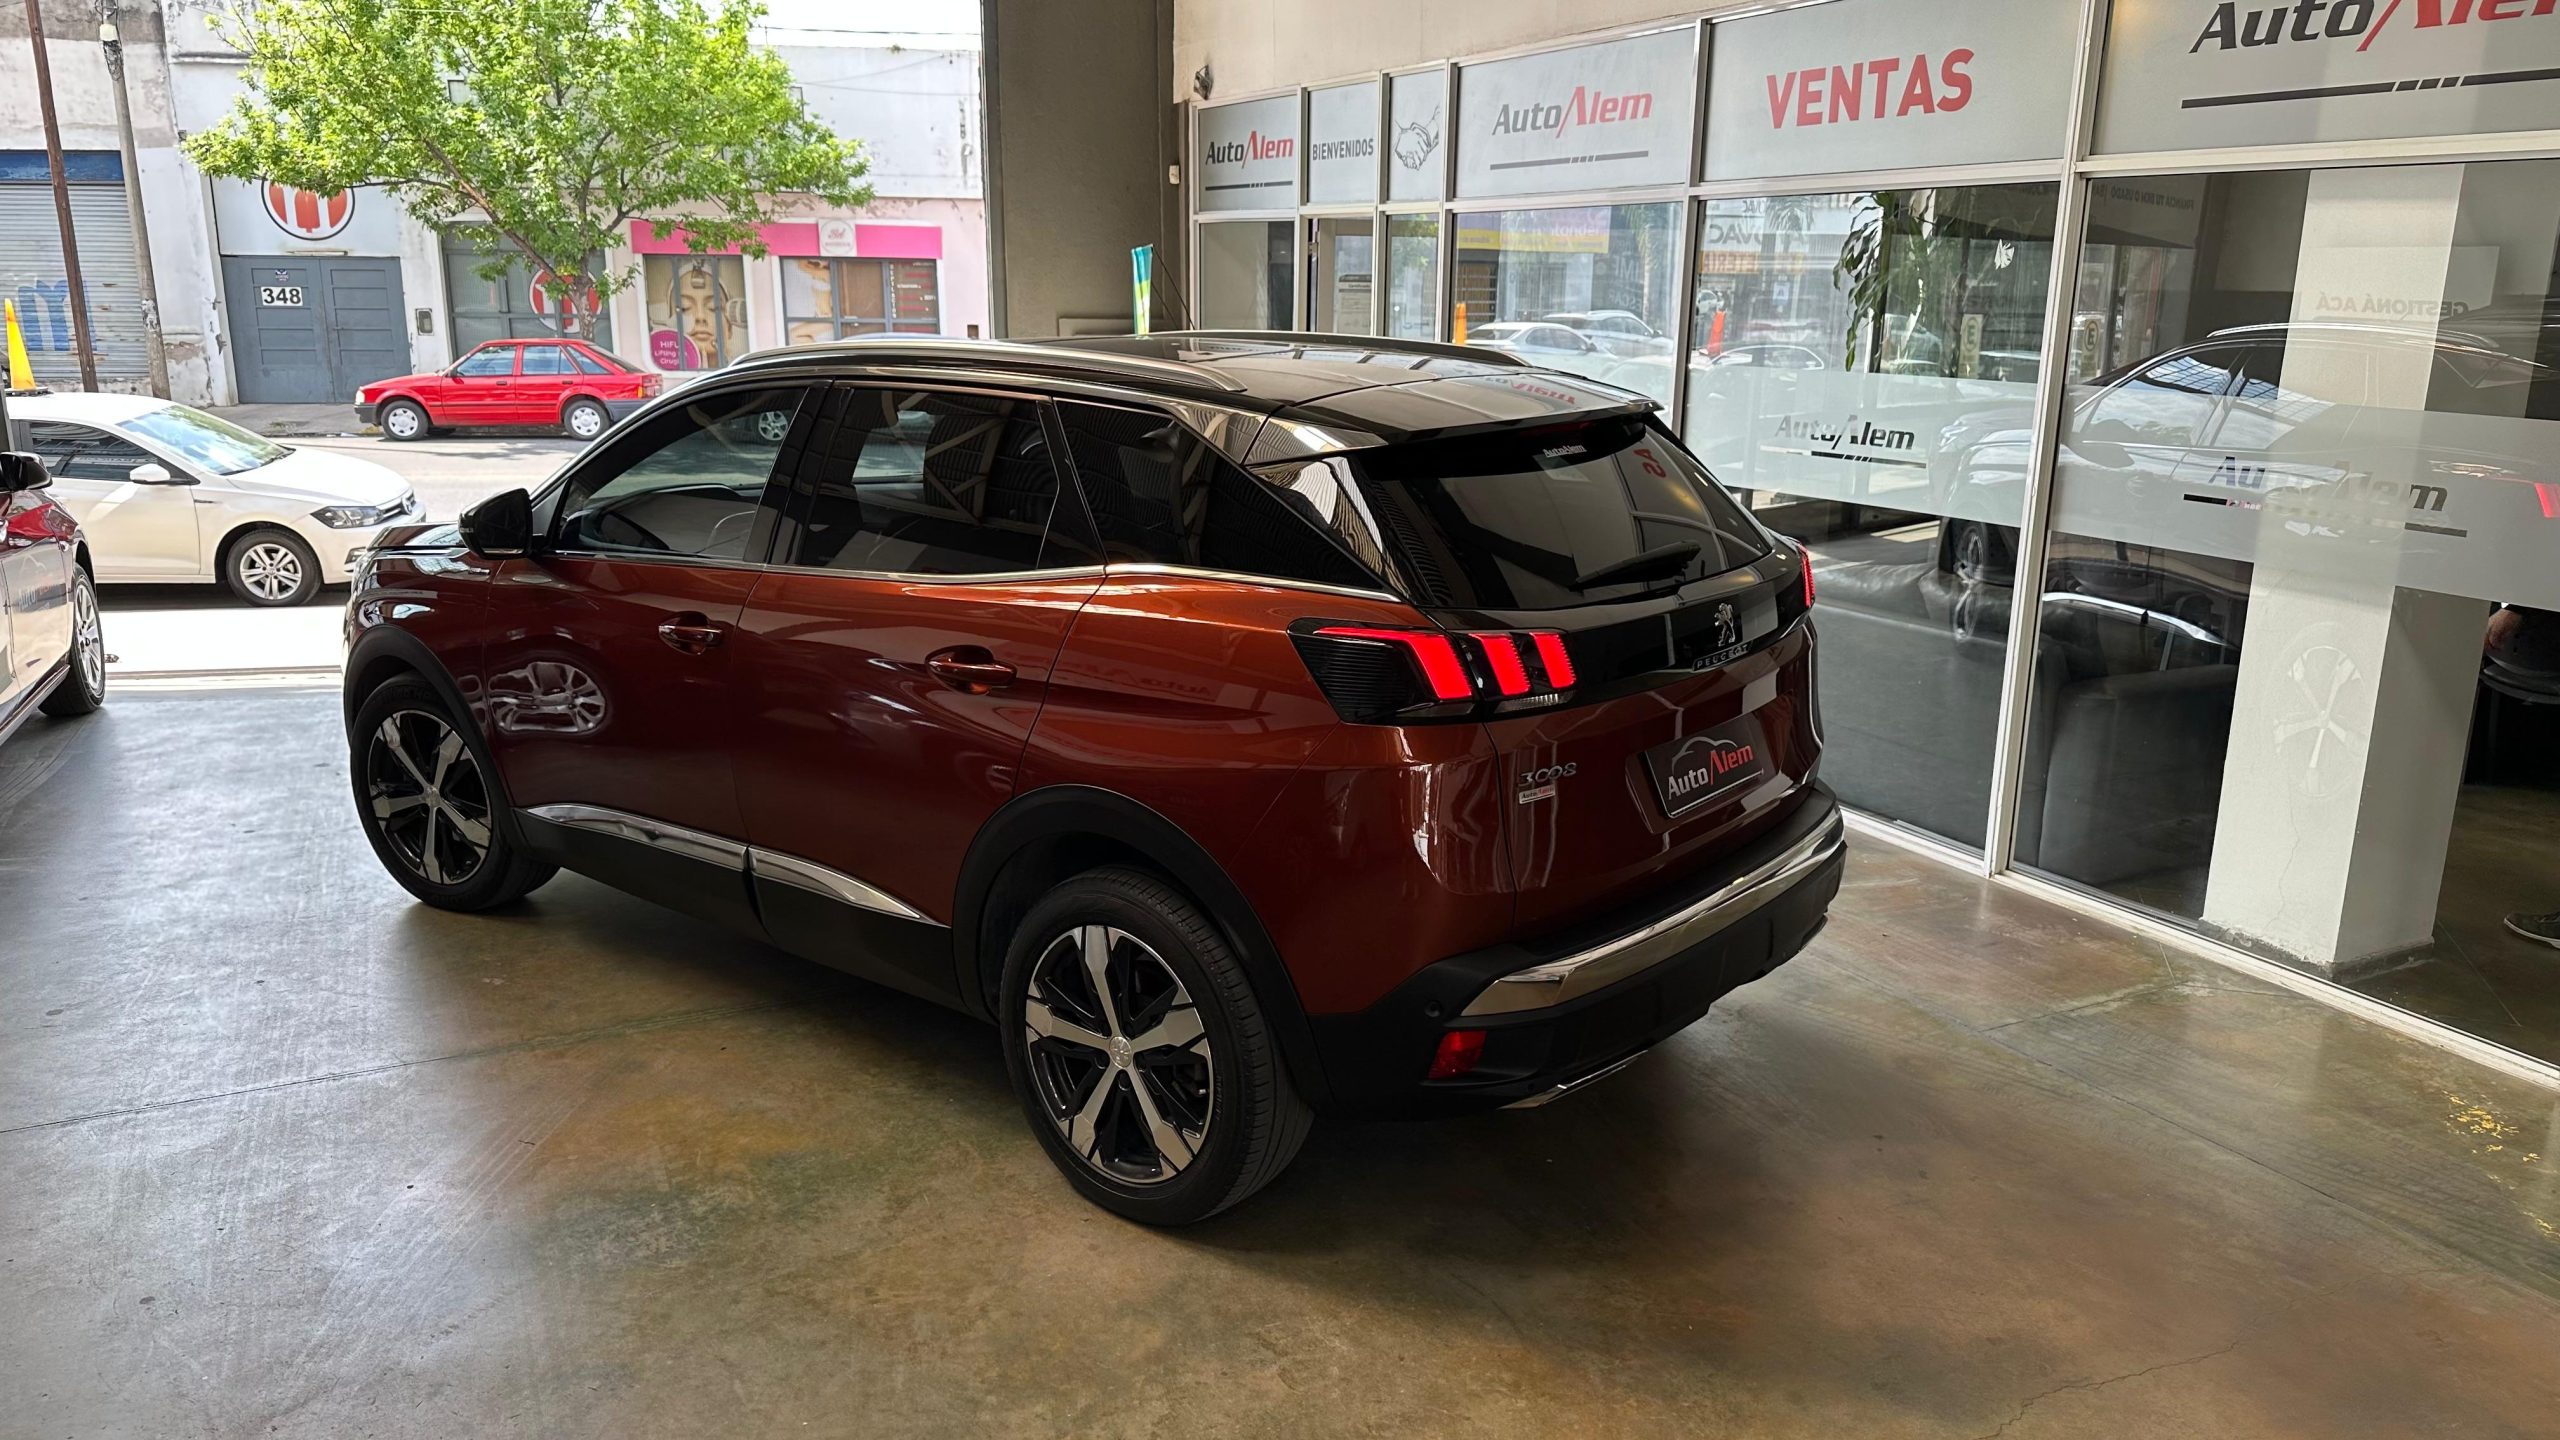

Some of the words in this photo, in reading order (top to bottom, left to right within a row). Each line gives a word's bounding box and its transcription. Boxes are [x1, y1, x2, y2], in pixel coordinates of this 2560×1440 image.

[1766, 48, 1975, 130] VENTAS
[1312, 138, 1374, 161] BIENVENIDOS
[263, 287, 302, 304] 348
[1697, 643, 1748, 669] PEUGEOT
[1519, 762, 1577, 786] 3008
